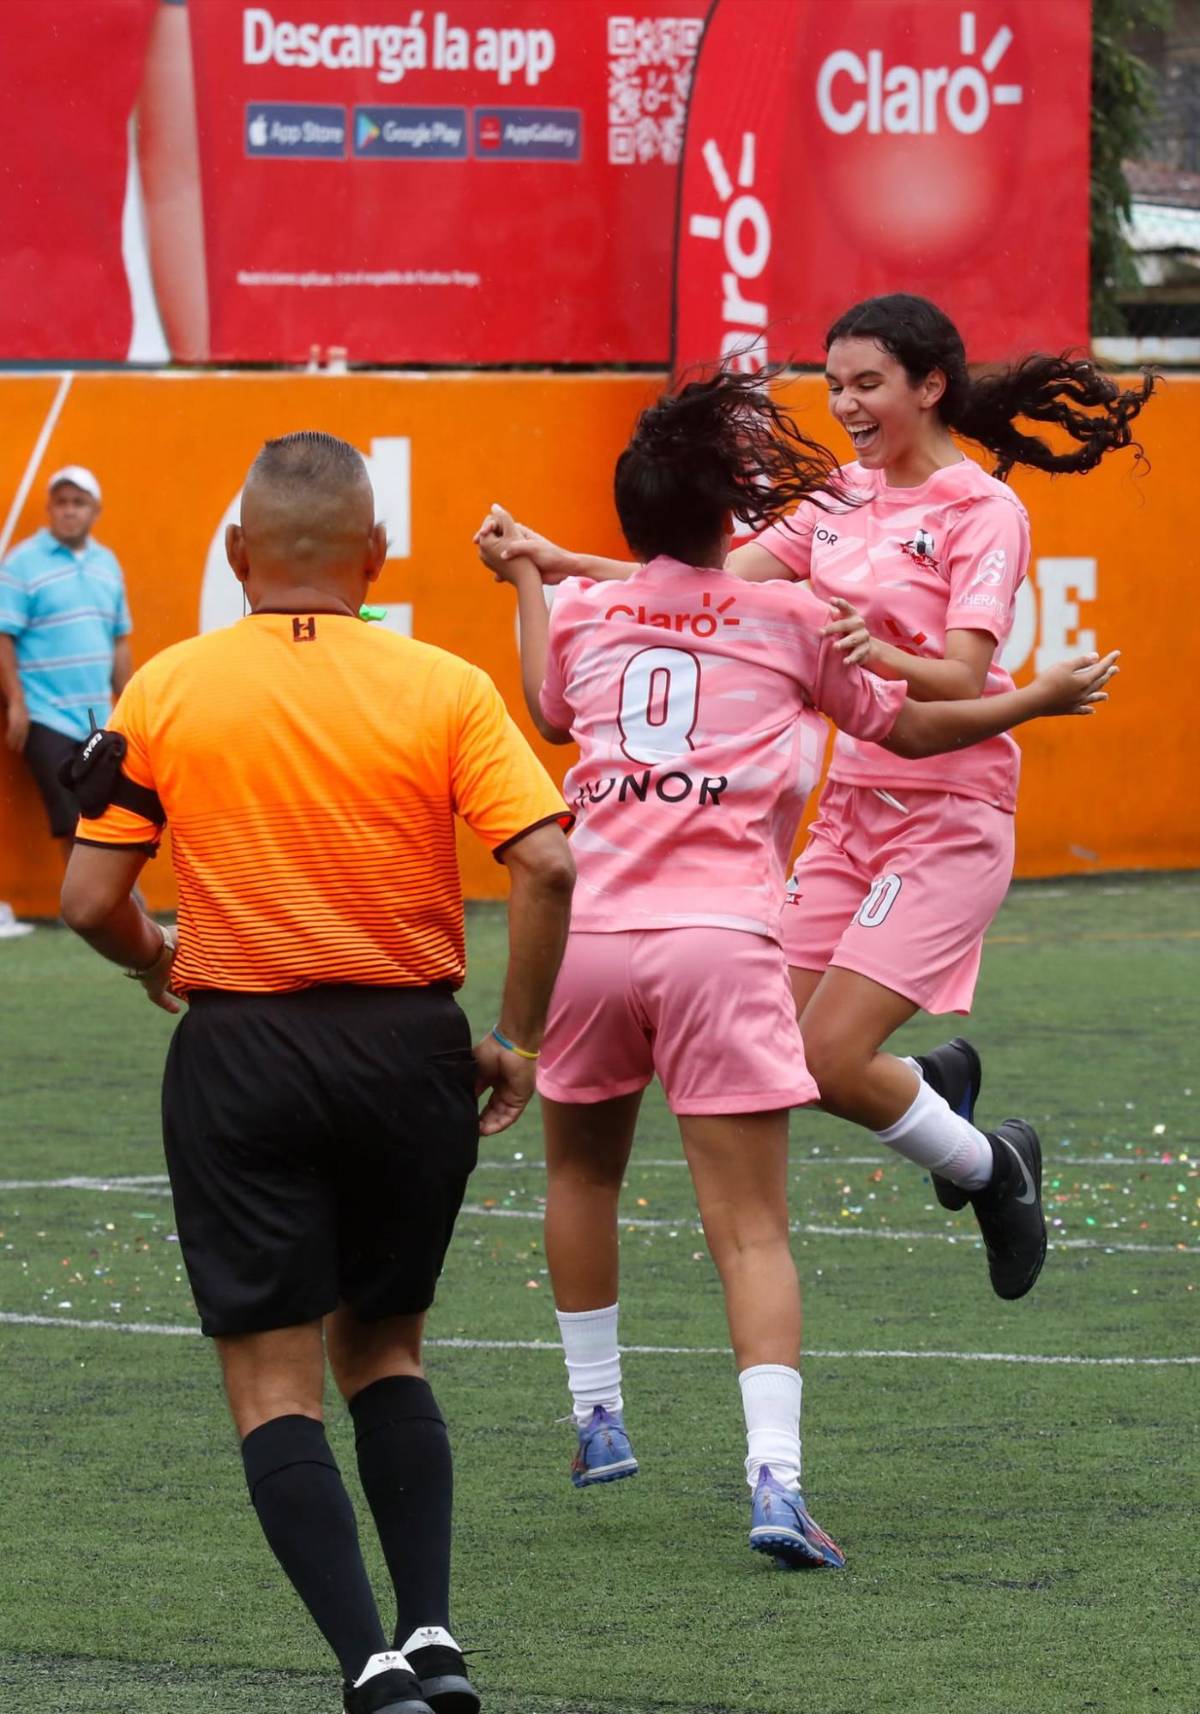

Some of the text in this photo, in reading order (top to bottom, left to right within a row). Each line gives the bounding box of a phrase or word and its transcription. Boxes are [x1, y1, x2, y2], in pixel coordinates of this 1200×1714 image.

[243, 8, 556, 86] Descargá la app
[816, 49, 990, 135] Claro
[270, 120, 344, 144] App Store
[383, 120, 463, 147] Google Play
[503, 122, 577, 147] AppGallery
